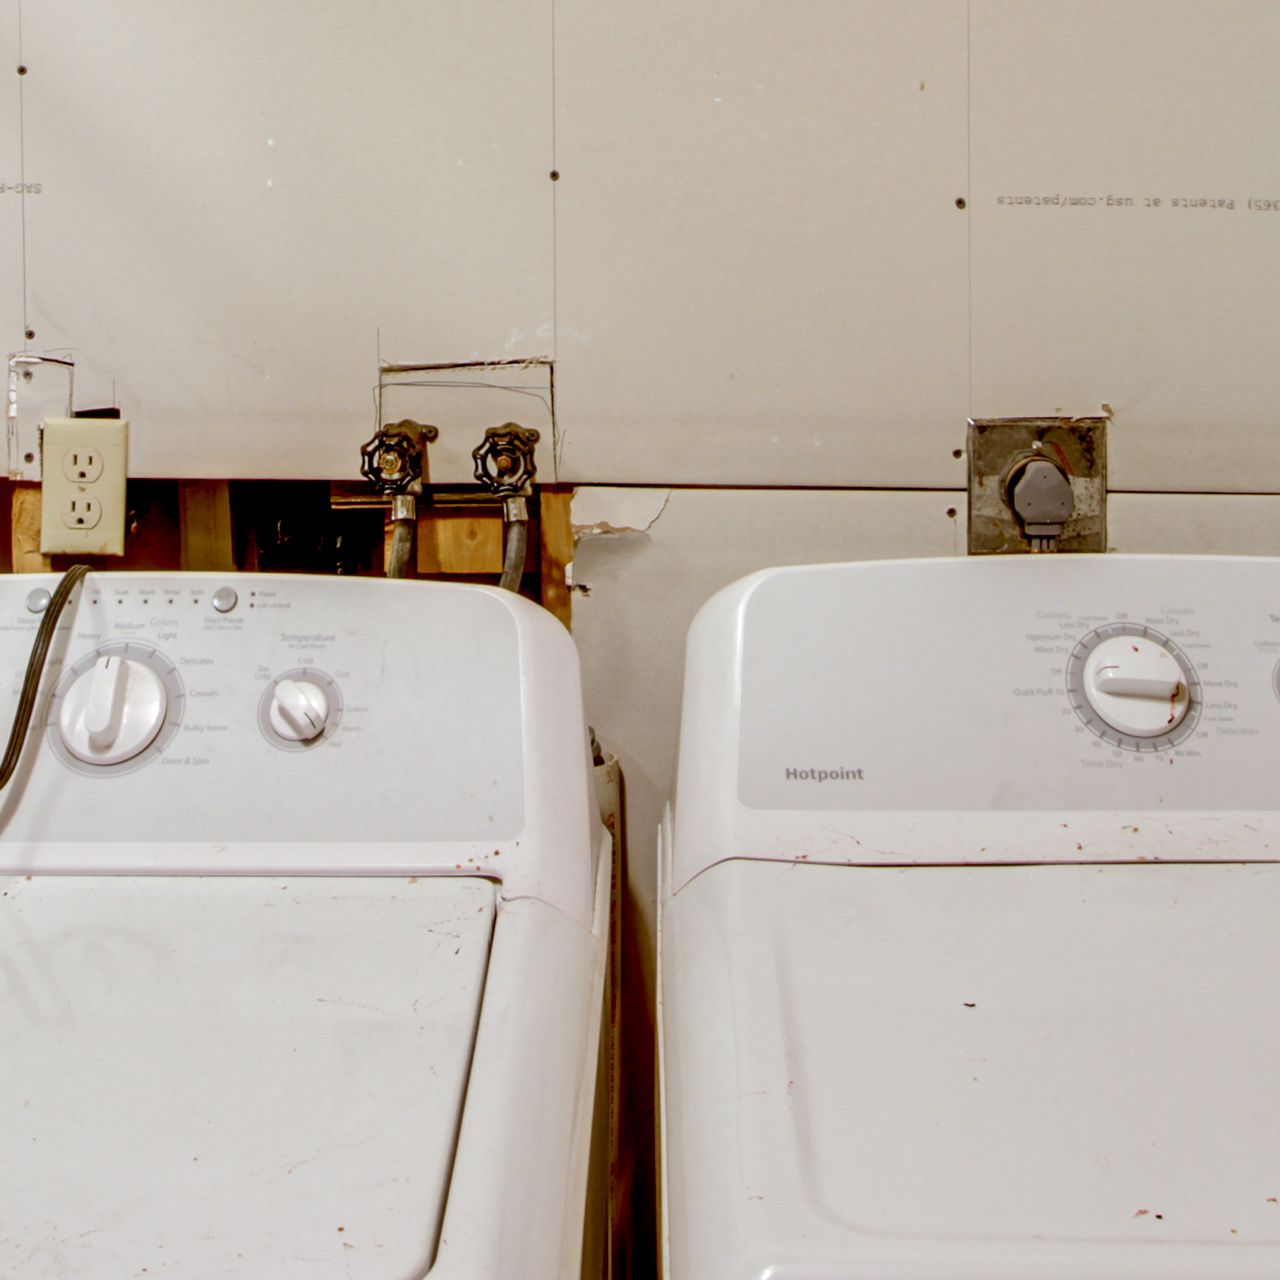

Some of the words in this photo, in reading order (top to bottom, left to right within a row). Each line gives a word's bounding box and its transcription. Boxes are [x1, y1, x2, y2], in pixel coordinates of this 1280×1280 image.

[996, 193, 1134, 208] usg.com/patents
[1143, 198, 1161, 210] at
[1170, 197, 1234, 211] Patents
[1076, 621, 1090, 630] Dry
[1165, 616, 1179, 626] Dry
[157, 631, 178, 641] Light
[280, 632, 337, 642] Temperature
[1026, 632, 1062, 642] Optimum
[1063, 632, 1076, 642] Dry
[1186, 629, 1200, 638] Dry
[1055, 645, 1069, 654] Dry
[1224, 679, 1239, 689] Dry
[1012, 687, 1034, 697] Quick
[1223, 700, 1238, 710] Dry
[1216, 726, 1259, 736] Delicates
[1105, 759, 1123, 769] Dry
[785, 767, 864, 783] Hotpoint
